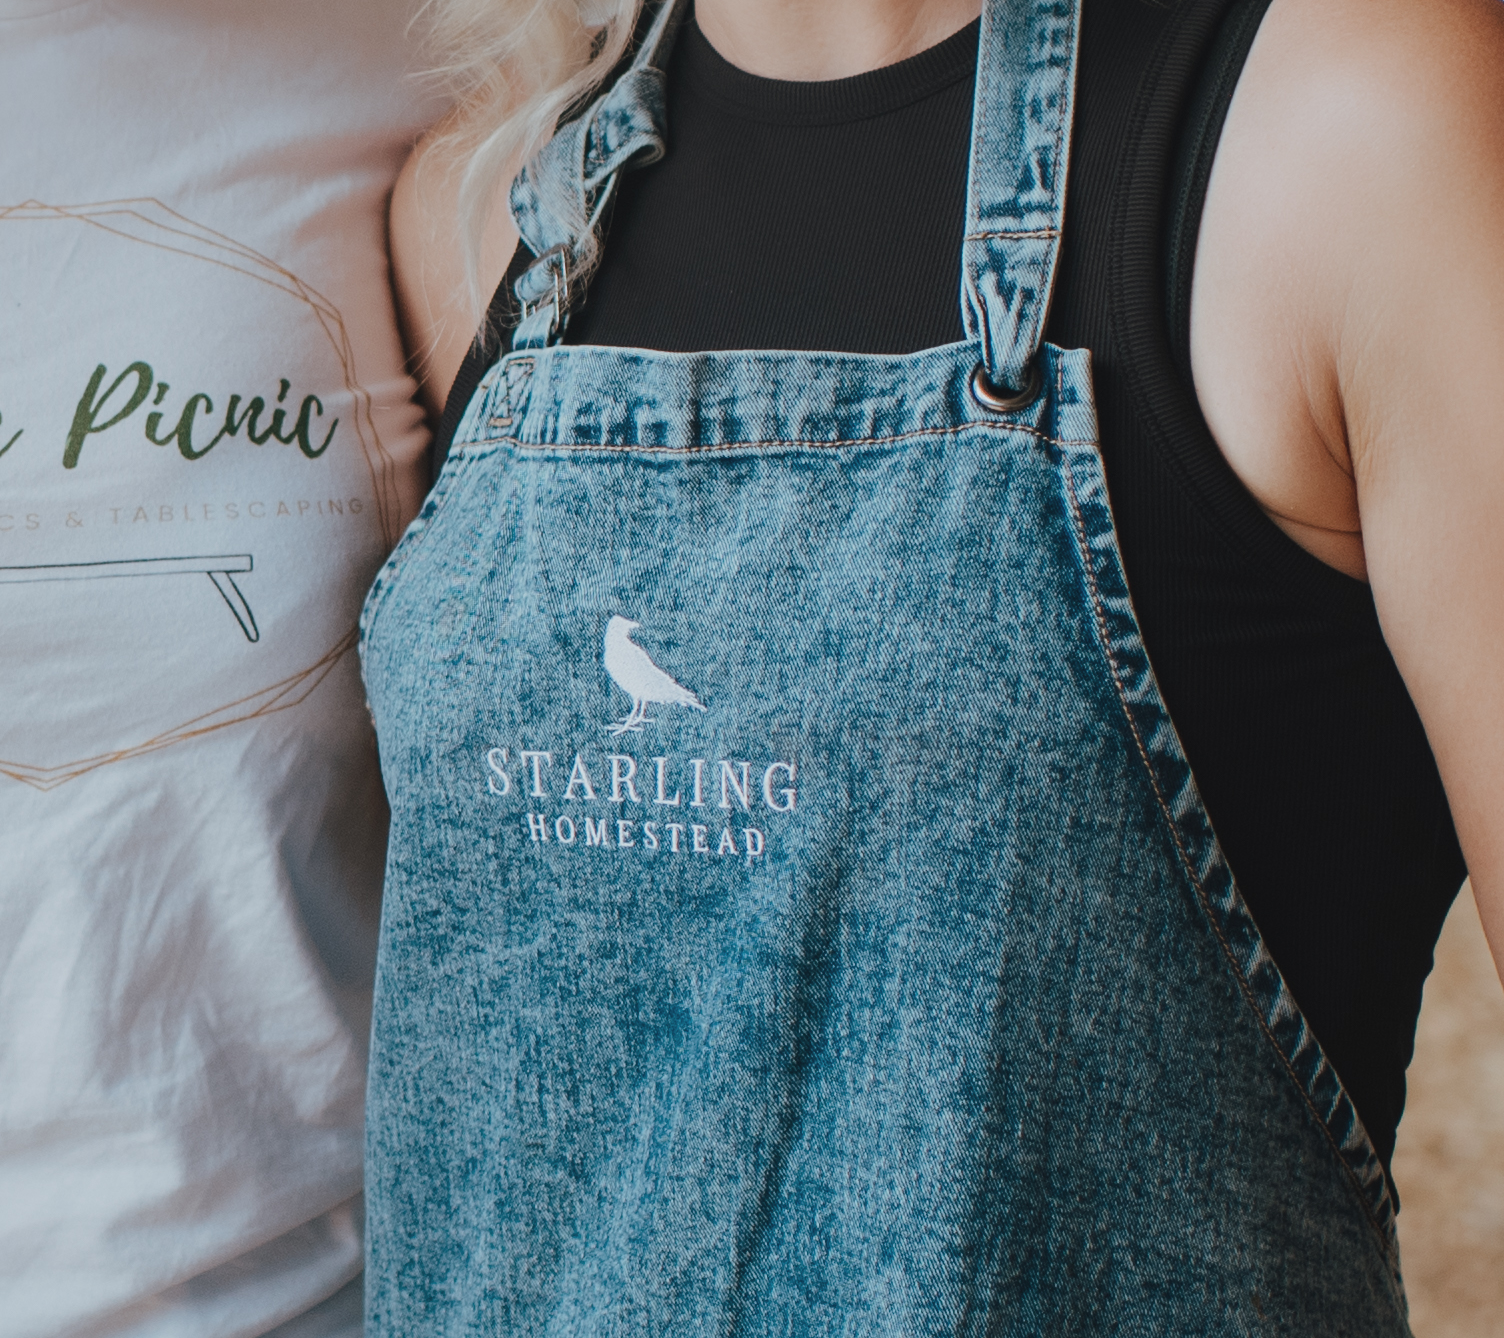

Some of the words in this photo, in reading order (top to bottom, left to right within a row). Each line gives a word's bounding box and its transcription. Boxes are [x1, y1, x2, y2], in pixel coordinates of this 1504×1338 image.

[62, 361, 340, 469] Picnic
[64, 510, 85, 529] &
[109, 496, 365, 526] TABLESCAPING
[487, 747, 797, 813] STARLING
[526, 813, 767, 858] HOMESTEAD
